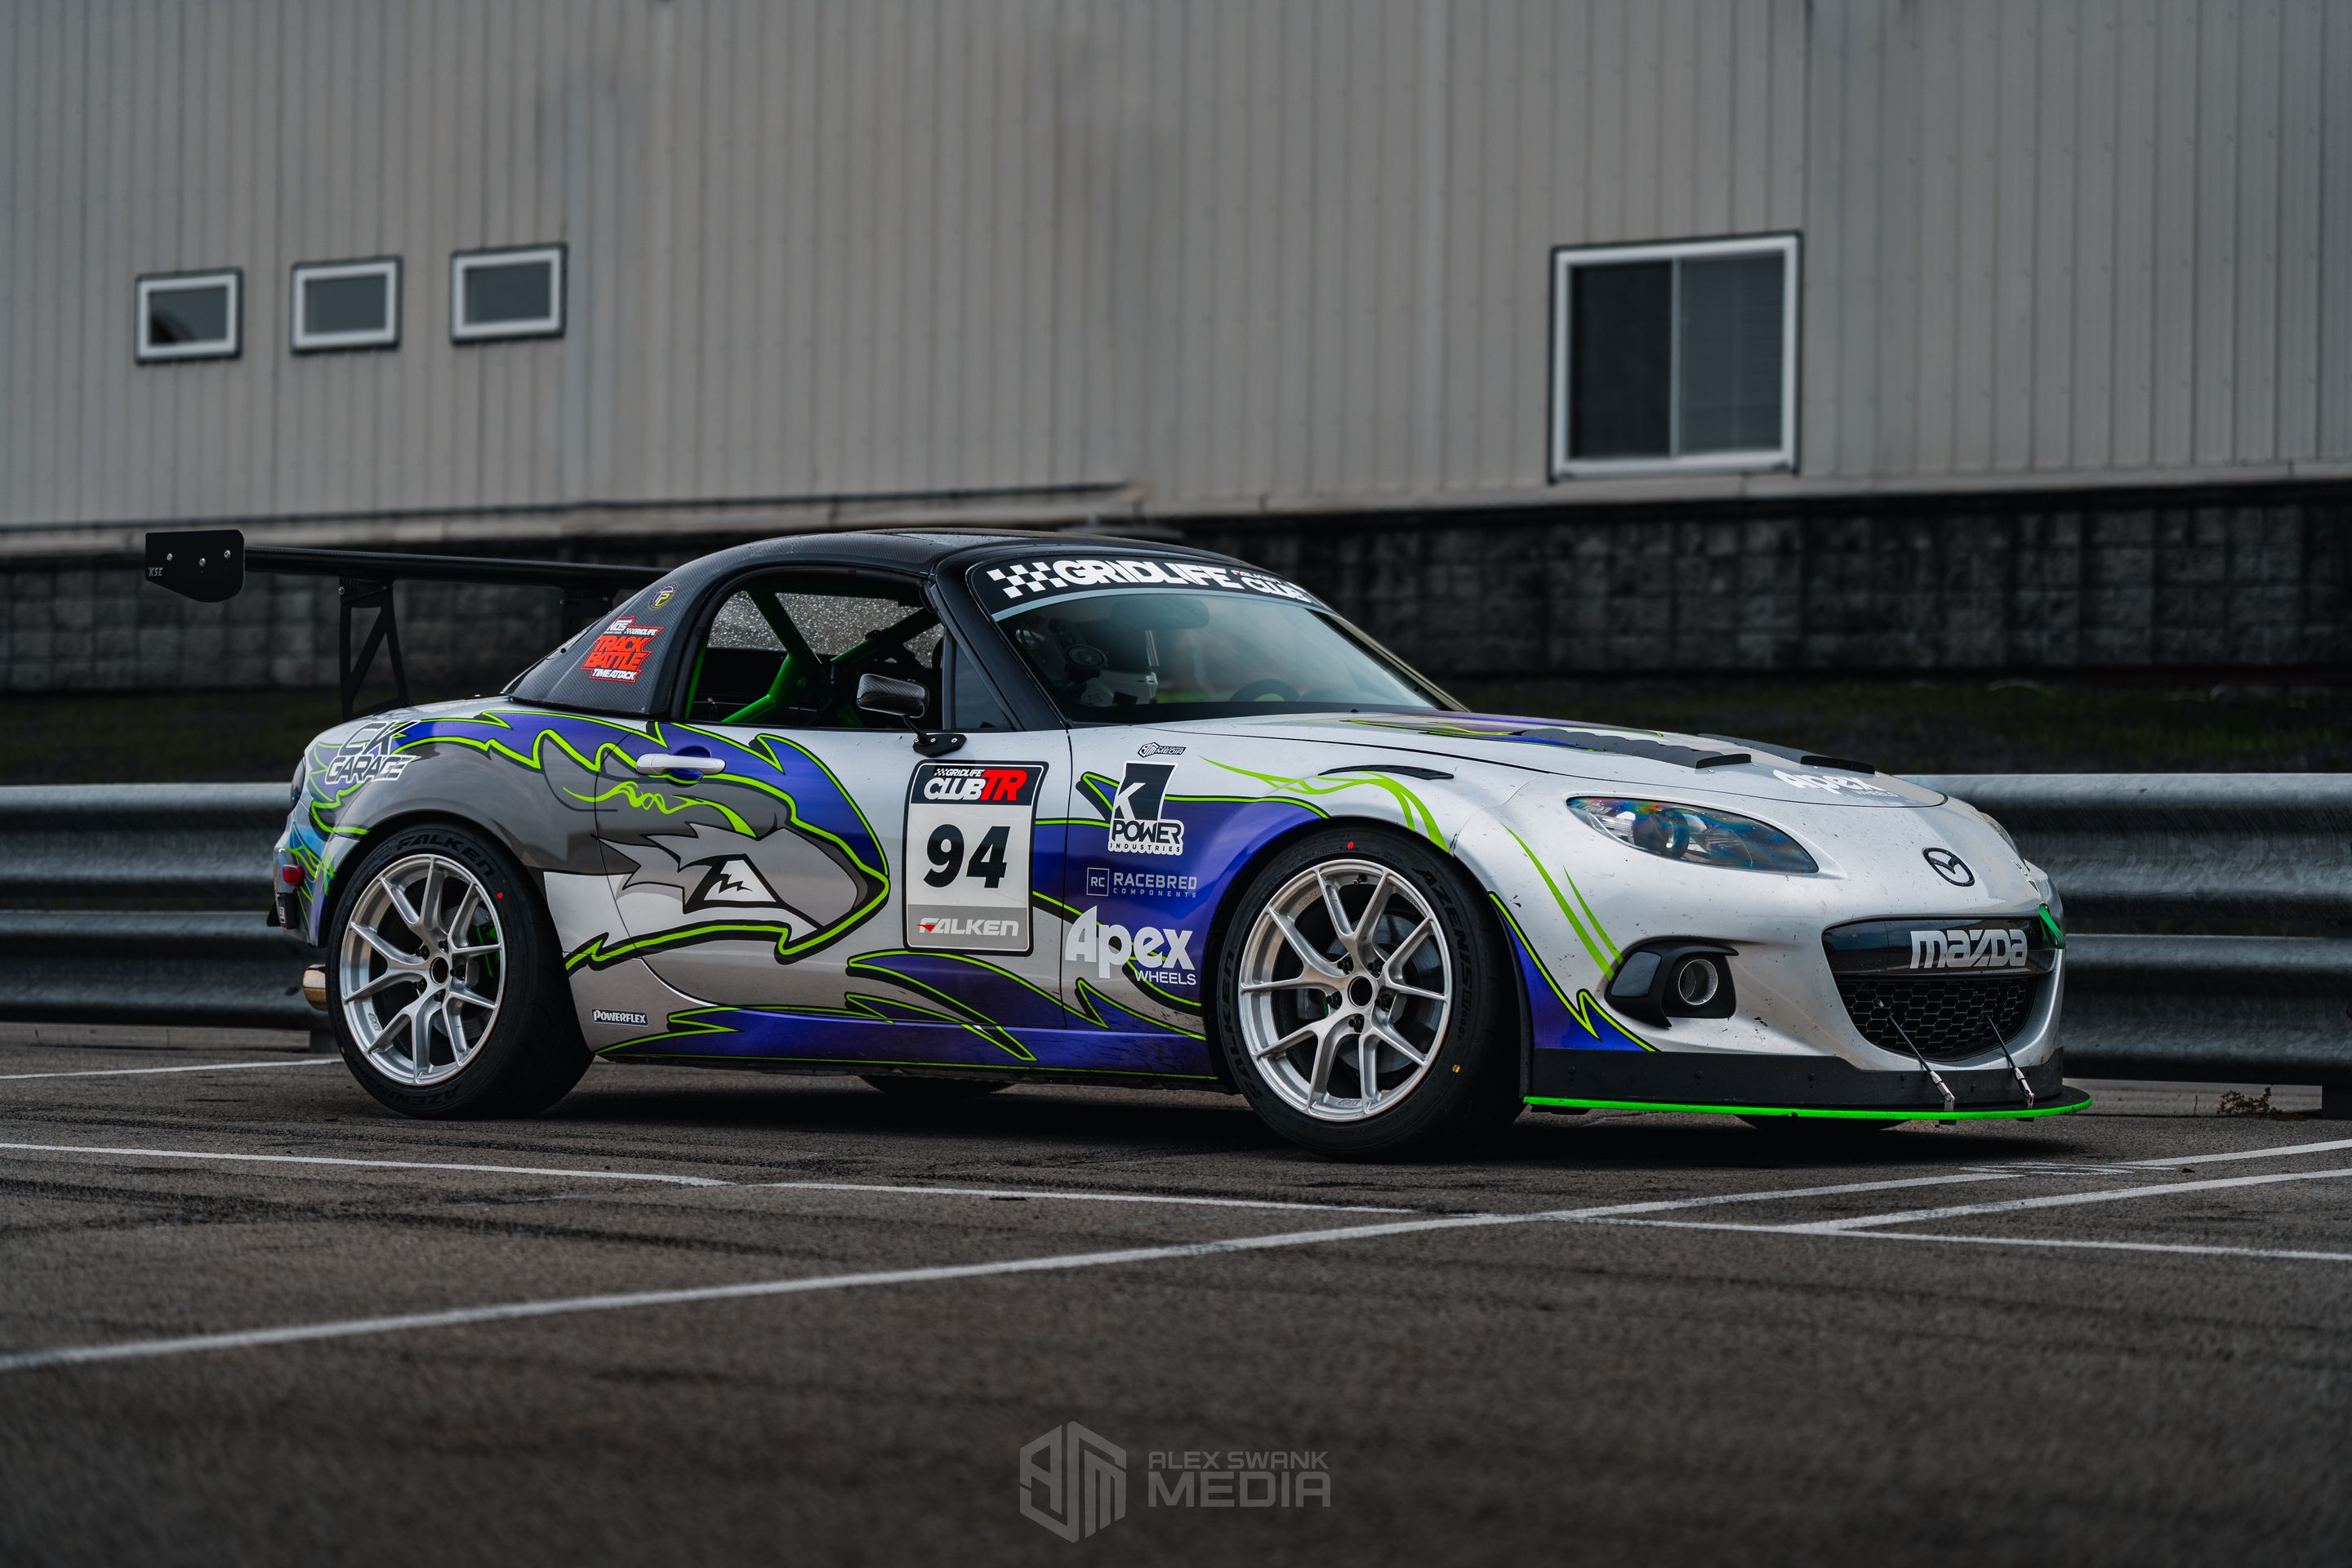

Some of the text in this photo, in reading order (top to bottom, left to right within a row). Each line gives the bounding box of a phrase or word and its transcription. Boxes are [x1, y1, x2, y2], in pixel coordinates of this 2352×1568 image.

[1052, 559, 1245, 589] GRIDLIFE
[607, 619, 633, 630] NOS
[594, 635, 650, 652] TRACK
[583, 652, 648, 670] BATTLE
[336, 719, 421, 756] CK
[325, 755, 417, 785] GARAGE
[946, 768, 985, 777] GRIDLIFE
[1111, 819, 1183, 844] POWER
[923, 823, 1011, 889] 94
[1110, 842, 1181, 853] INDUSTRIES
[1113, 872, 1197, 890] RACEBRED
[1113, 887, 1196, 898] COMPONENTS
[916, 917, 1019, 937] FALKEN
[1135, 969, 1196, 985] WHEELS
[593, 1009, 646, 1023] POWERFLEX
